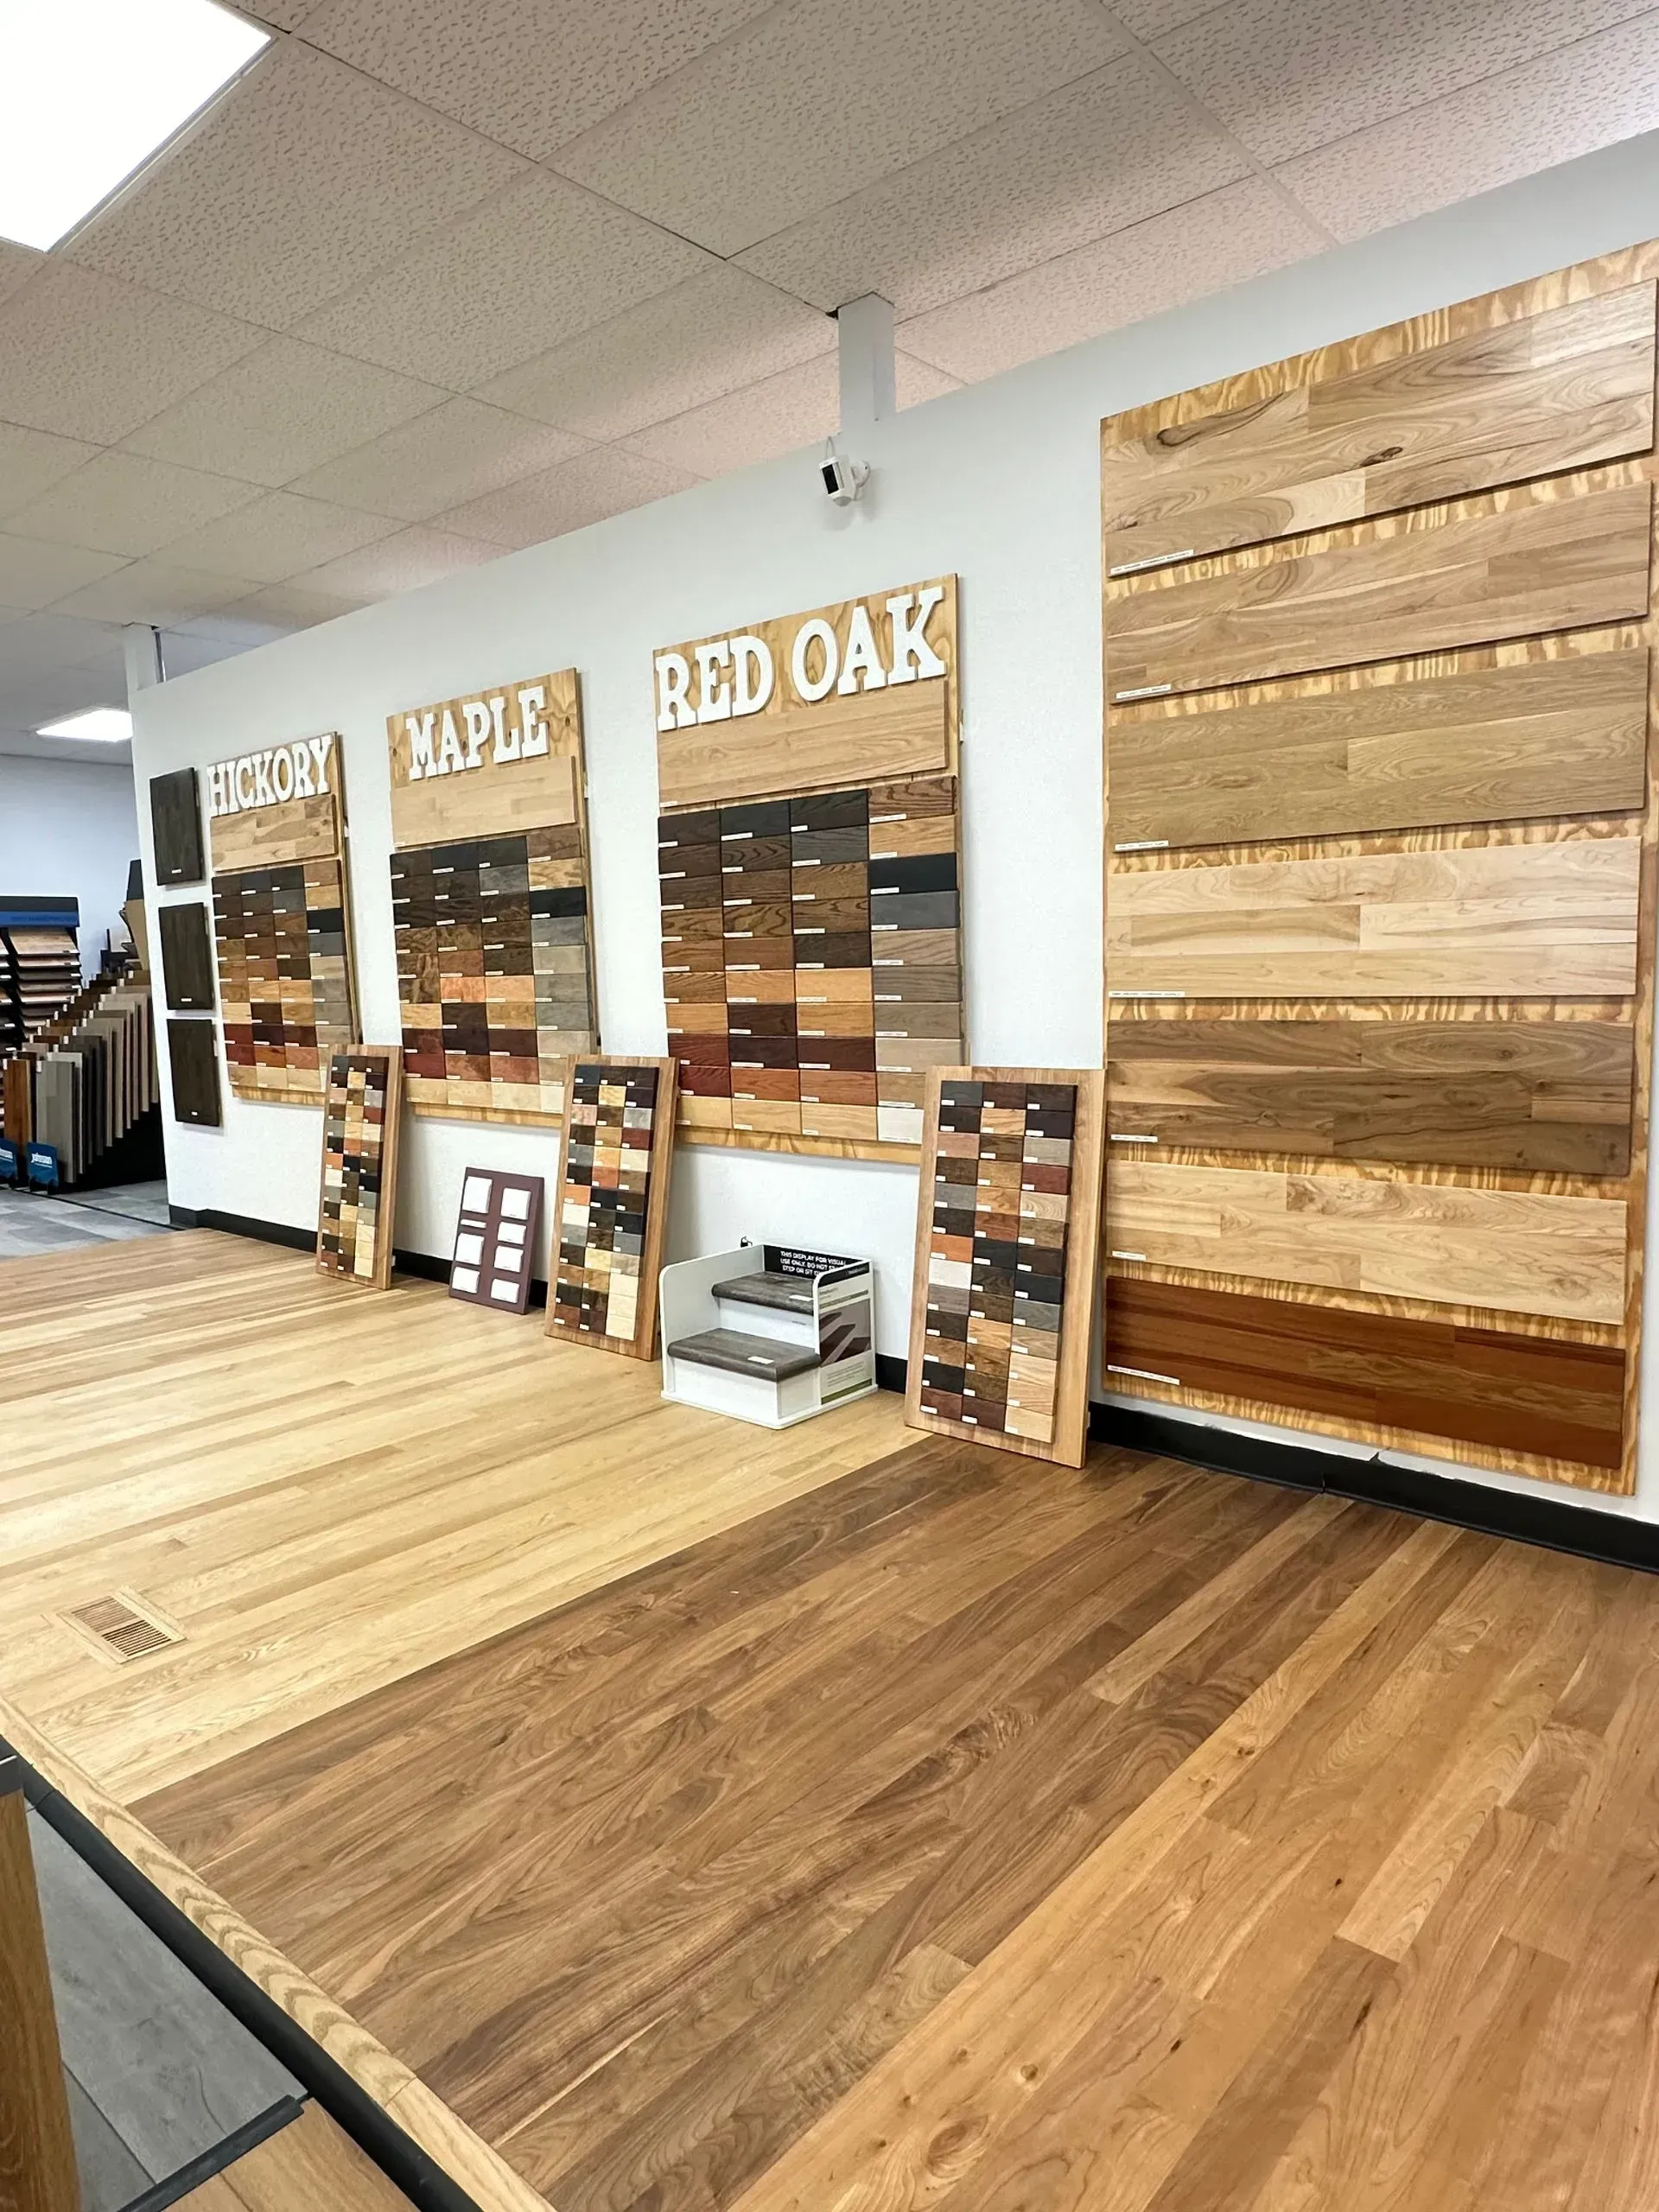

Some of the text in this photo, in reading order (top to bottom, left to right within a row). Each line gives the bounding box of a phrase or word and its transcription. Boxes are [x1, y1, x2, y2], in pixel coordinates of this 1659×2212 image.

[656, 586, 947, 732] RED OAK
[207, 734, 333, 817] HICKORY
[405, 685, 549, 780] MAPLE
[792, 1252, 815, 1261] DISPLAY
